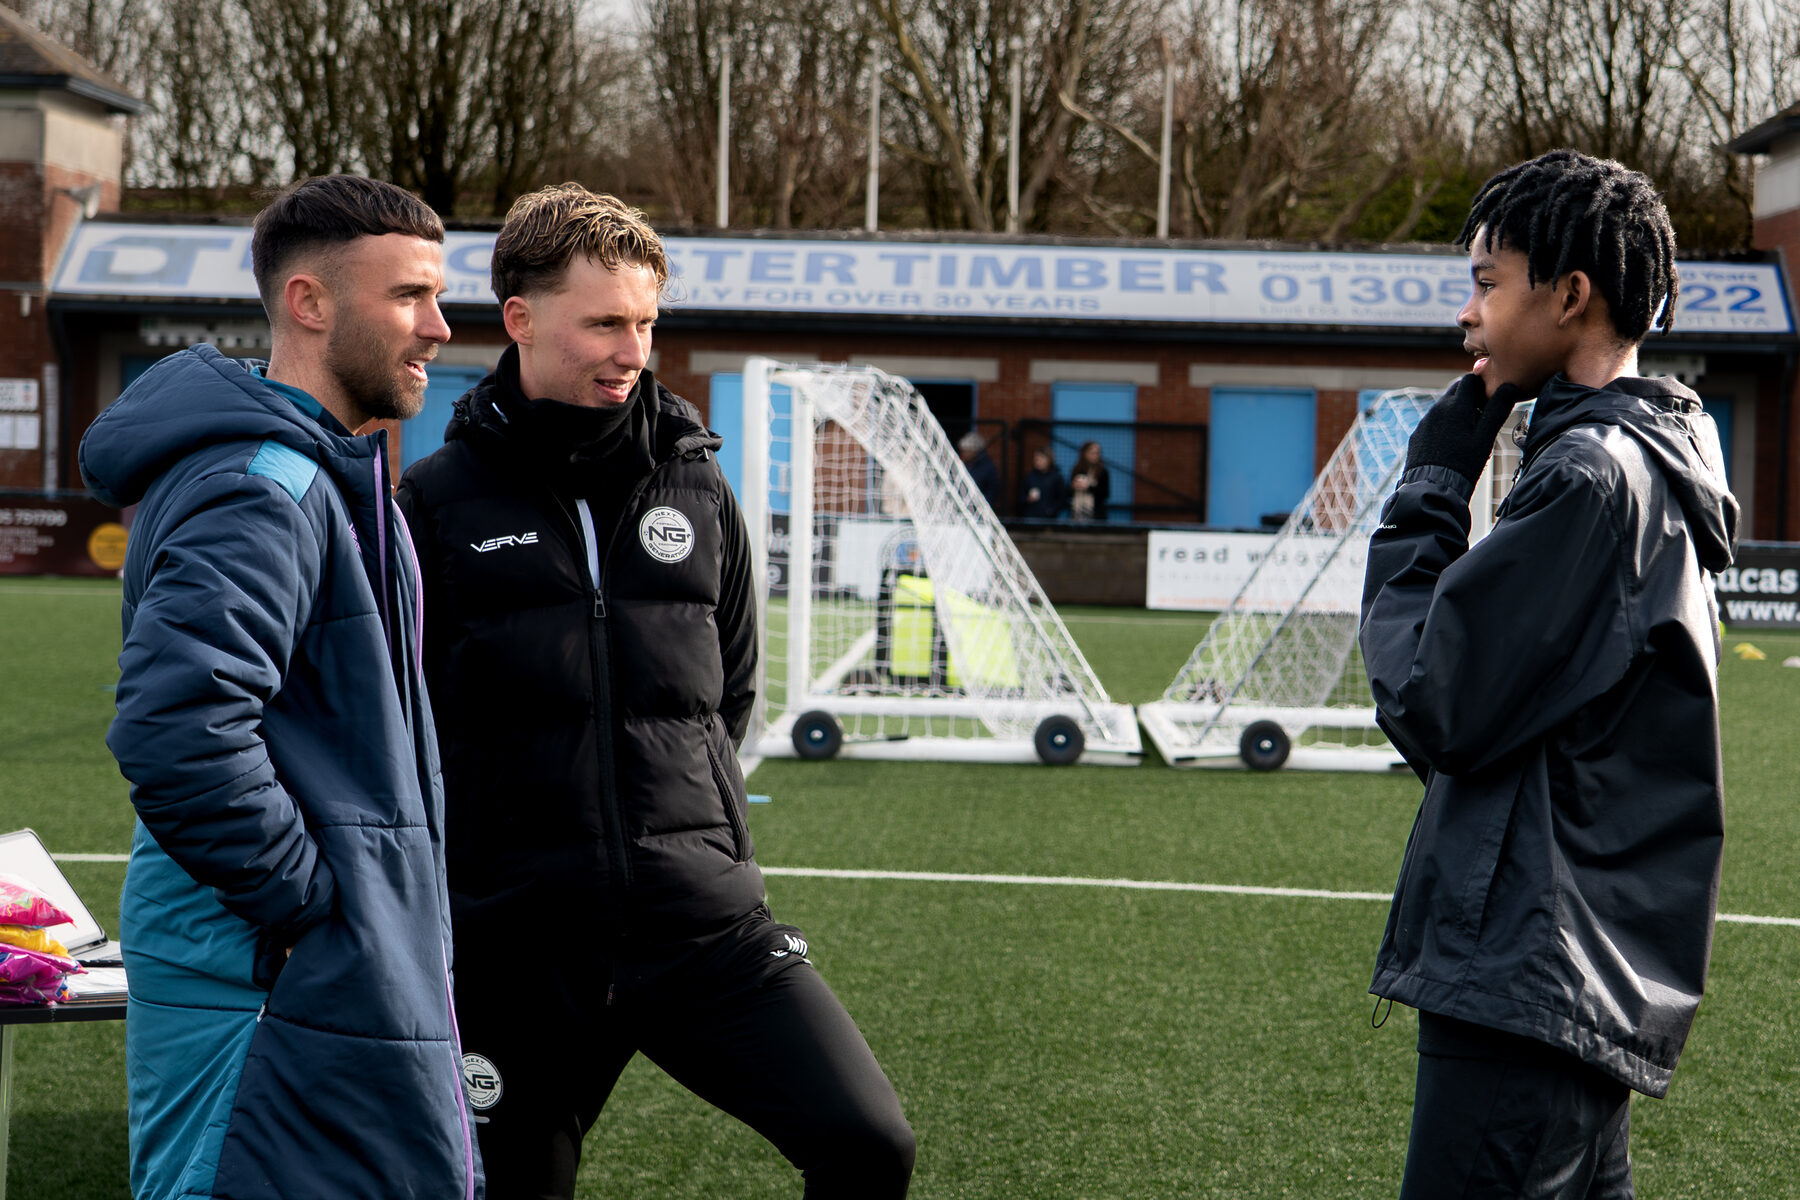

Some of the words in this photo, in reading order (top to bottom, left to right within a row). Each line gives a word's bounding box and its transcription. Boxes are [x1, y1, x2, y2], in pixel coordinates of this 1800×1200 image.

[879, 252, 1229, 295] TIMBER
[744, 289, 814, 305] FOR
[827, 290, 921, 307] OVER
[933, 292, 972, 308] 30
[983, 294, 1101, 312] YEARS
[1260, 273, 1473, 308] 01305
[470, 531, 539, 553] VERVE
[648, 525, 687, 543] NG
[648, 542, 688, 559] GENERATION
[1159, 546, 1229, 564] read
